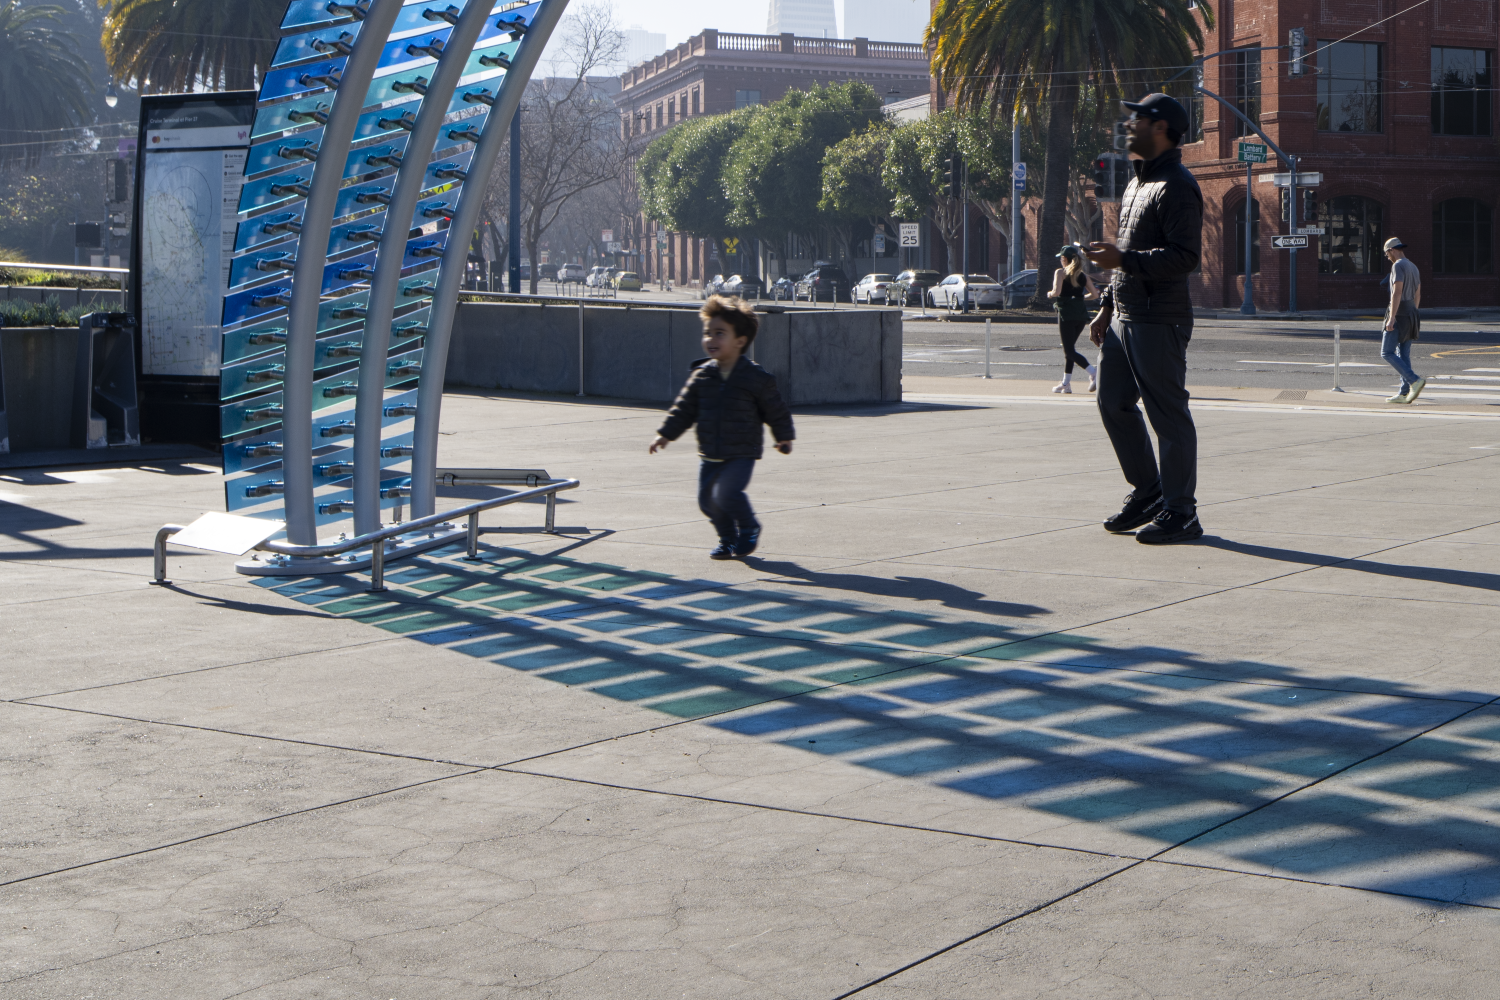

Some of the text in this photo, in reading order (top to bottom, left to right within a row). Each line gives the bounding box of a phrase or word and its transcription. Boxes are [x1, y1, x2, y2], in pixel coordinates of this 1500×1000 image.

[238, 131, 246, 140] lyft
[1243, 144, 1263, 153] Lombard
[1243, 153, 1261, 162] Battery
[902, 235, 917, 245] 25
